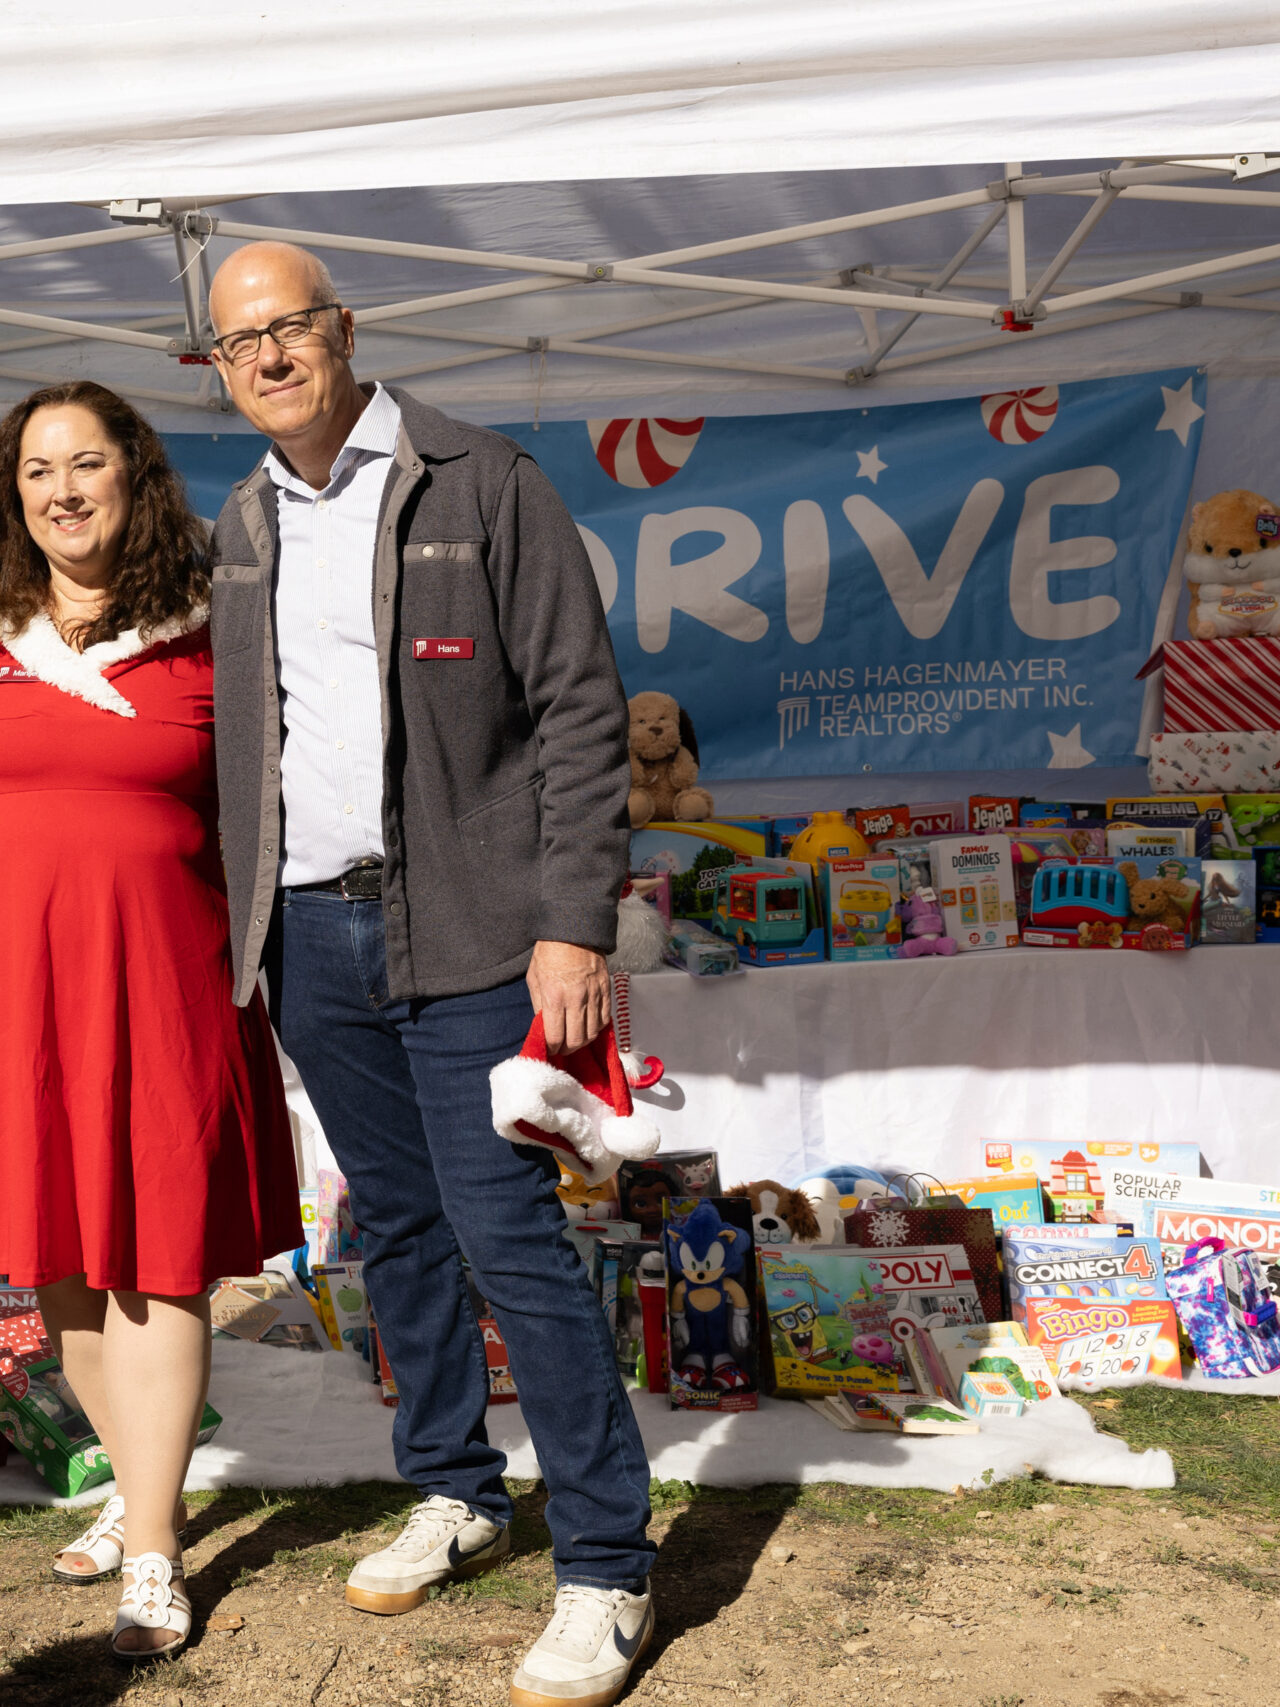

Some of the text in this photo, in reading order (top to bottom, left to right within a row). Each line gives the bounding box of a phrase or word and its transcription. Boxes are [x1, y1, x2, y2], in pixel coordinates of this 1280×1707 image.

[438, 645, 460, 653] Hans
[780, 658, 1067, 692] HANS HAGENMAYER
[816, 684, 1095, 716] TEAMPROVIDENT INC.
[973, 803, 1014, 828] Jenga
[1114, 802, 1197, 816] SUPREME
[863, 814, 894, 835] Jenga
[961, 846, 989, 854] FAMILY
[1120, 846, 1175, 856] WHALES
[952, 853, 1000, 868] DOMINOES
[1142, 1148, 1156, 1158] 3+
[1114, 1173, 1181, 1190] POPULAR
[1115, 1185, 1178, 1200] SCIENCE
[999, 1201, 1031, 1221] Out
[1018, 1247, 1153, 1283] CONNECT 4
[1041, 1310, 1124, 1337] Bingo
[1086, 1338, 1104, 1353] 12
[1135, 1331, 1149, 1346] 8
[1101, 1358, 1121, 1374] 20
[685, 1392, 720, 1400] SONIC
